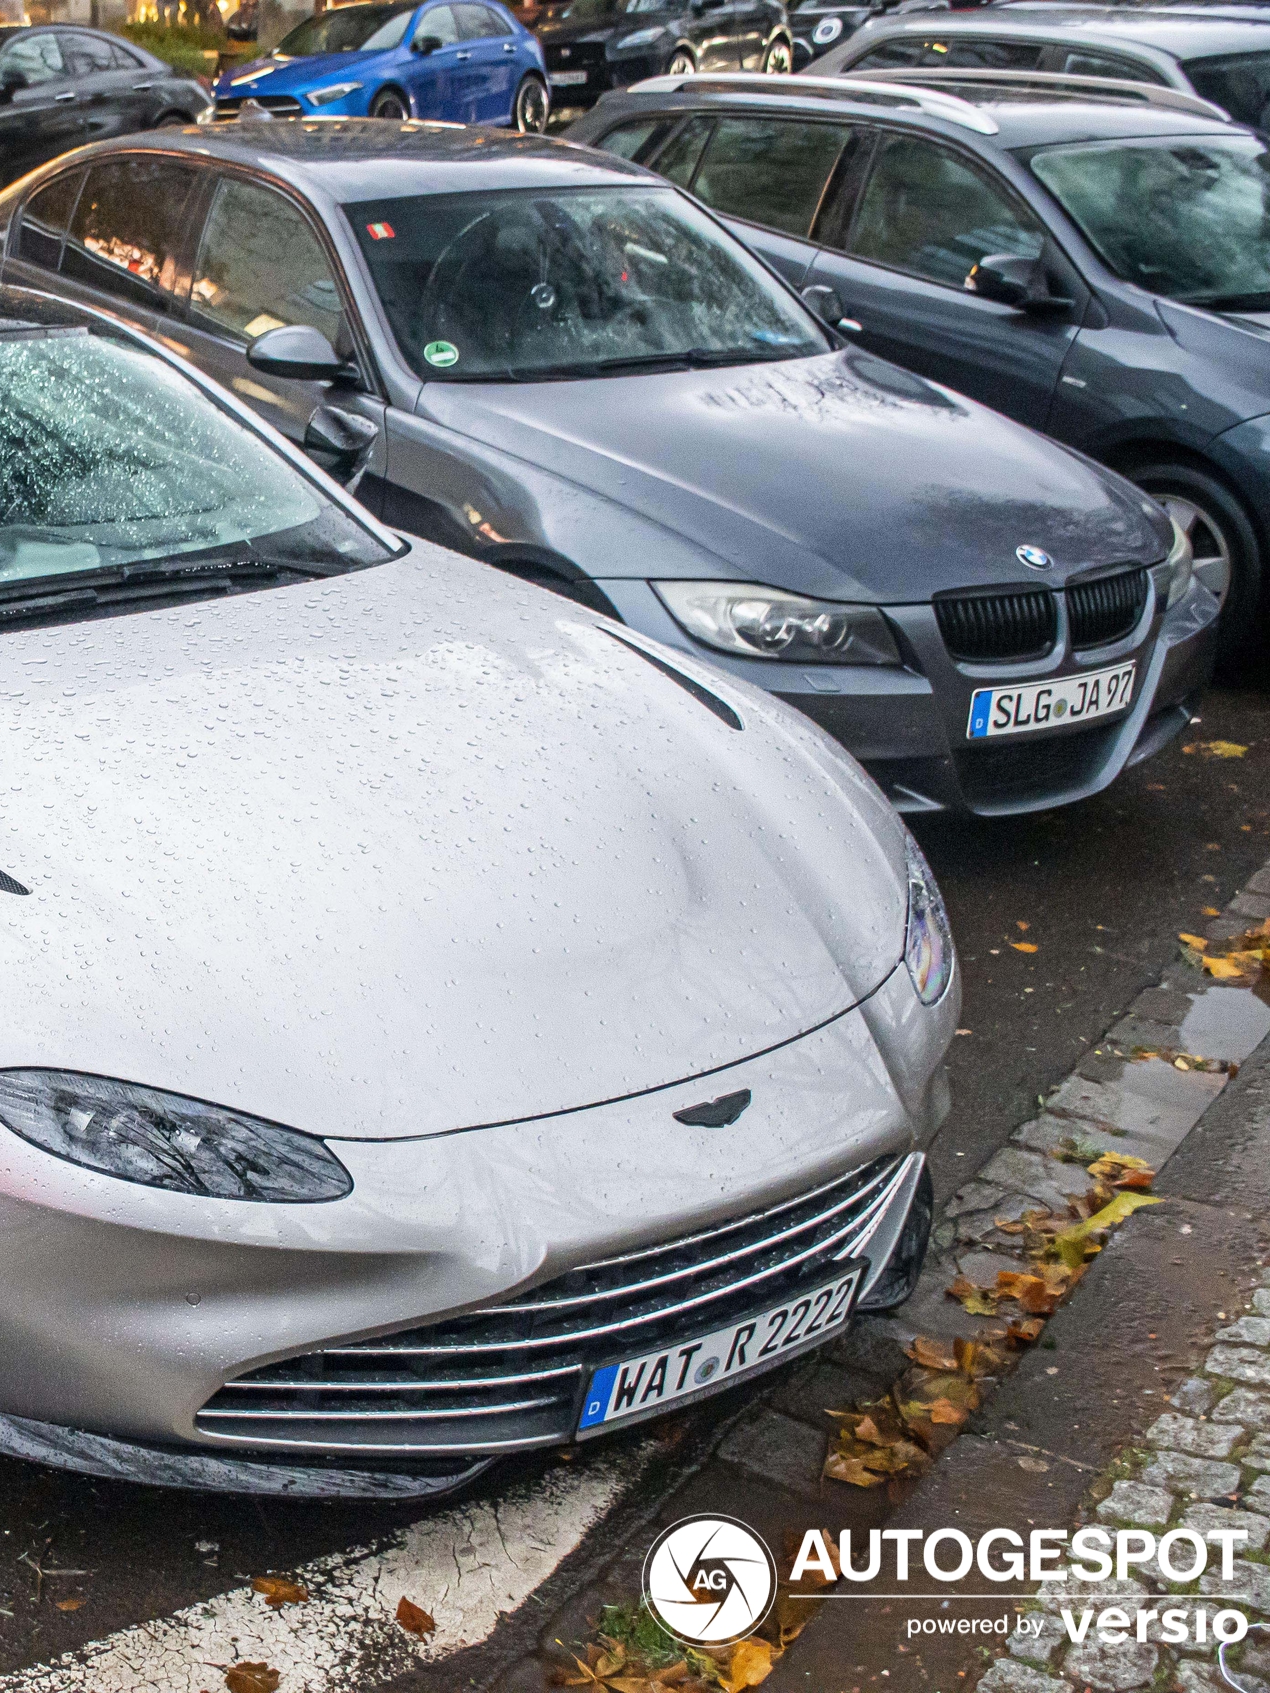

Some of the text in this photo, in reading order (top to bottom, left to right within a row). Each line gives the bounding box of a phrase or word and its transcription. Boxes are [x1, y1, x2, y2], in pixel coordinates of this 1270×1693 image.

[975, 669, 1133, 730] D SLG JA 97
[587, 1401, 601, 1416] D
[613, 1342, 703, 1412] WAT
[724, 1322, 757, 1372] R
[757, 1276, 854, 1358] 2222
